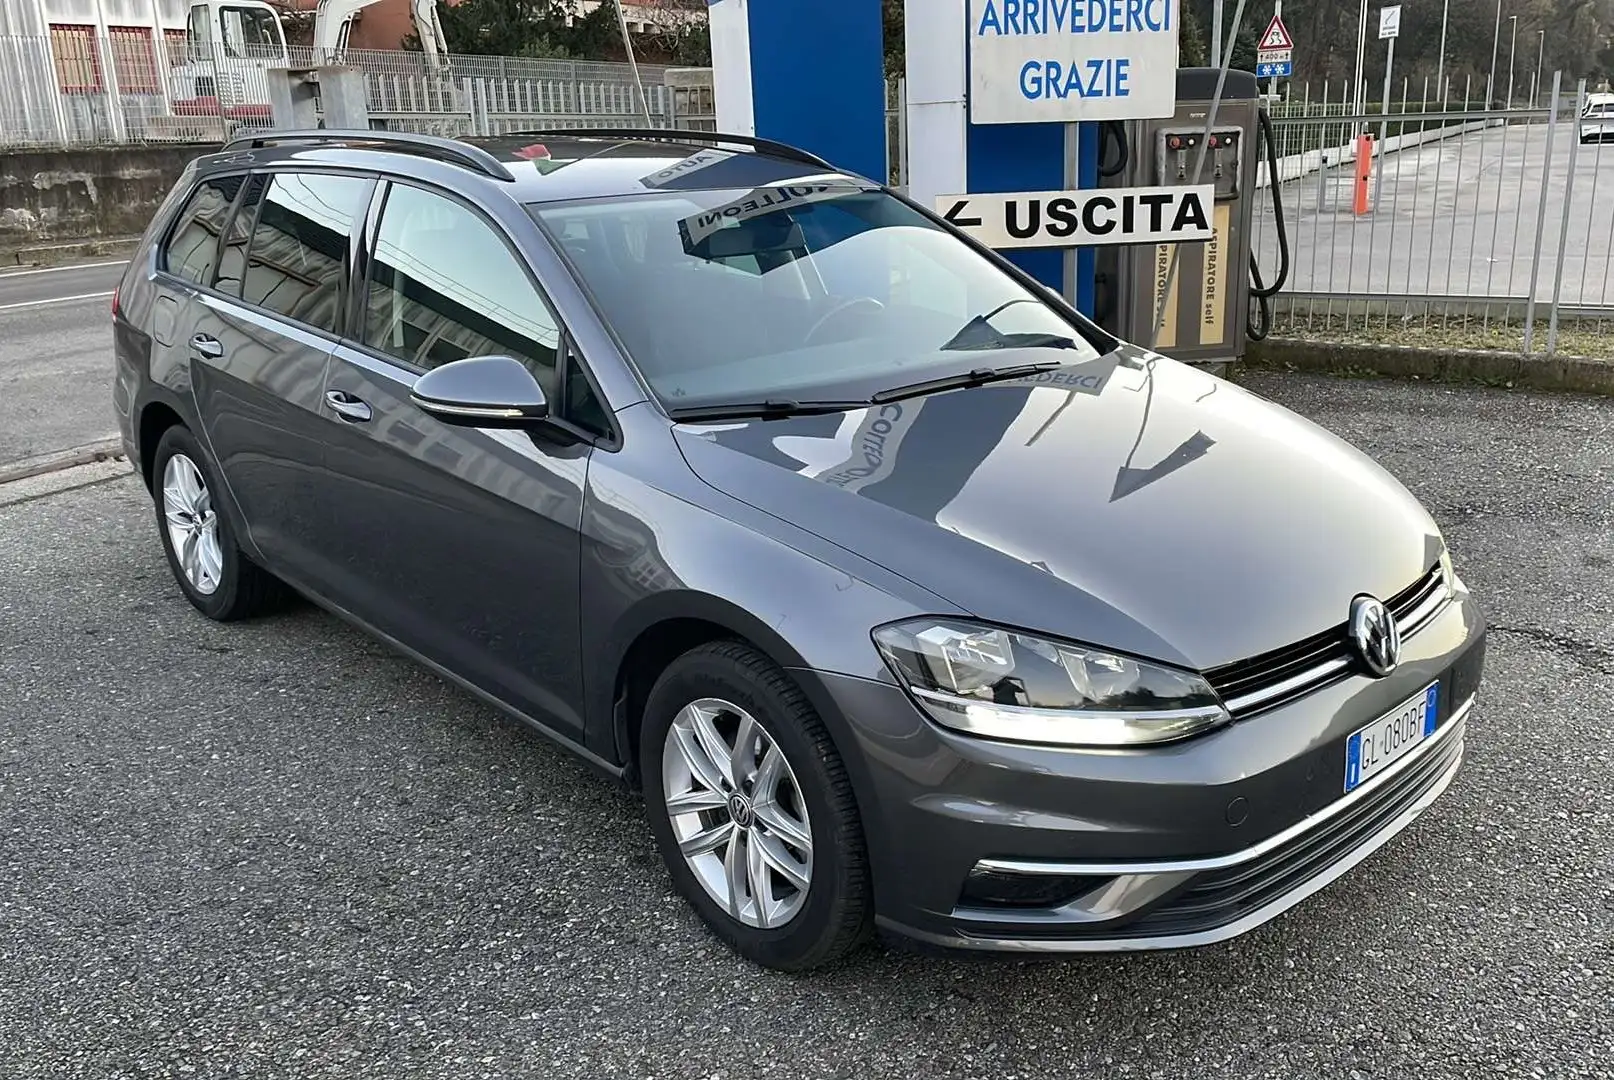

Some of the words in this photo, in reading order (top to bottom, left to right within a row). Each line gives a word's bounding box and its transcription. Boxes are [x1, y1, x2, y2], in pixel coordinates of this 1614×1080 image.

[978, 0, 1170, 36] ARRIVEDERCI
[1019, 58, 1130, 100] GRAZIE
[1004, 193, 1209, 239] USCITA
[1205, 303, 1214, 325] self
